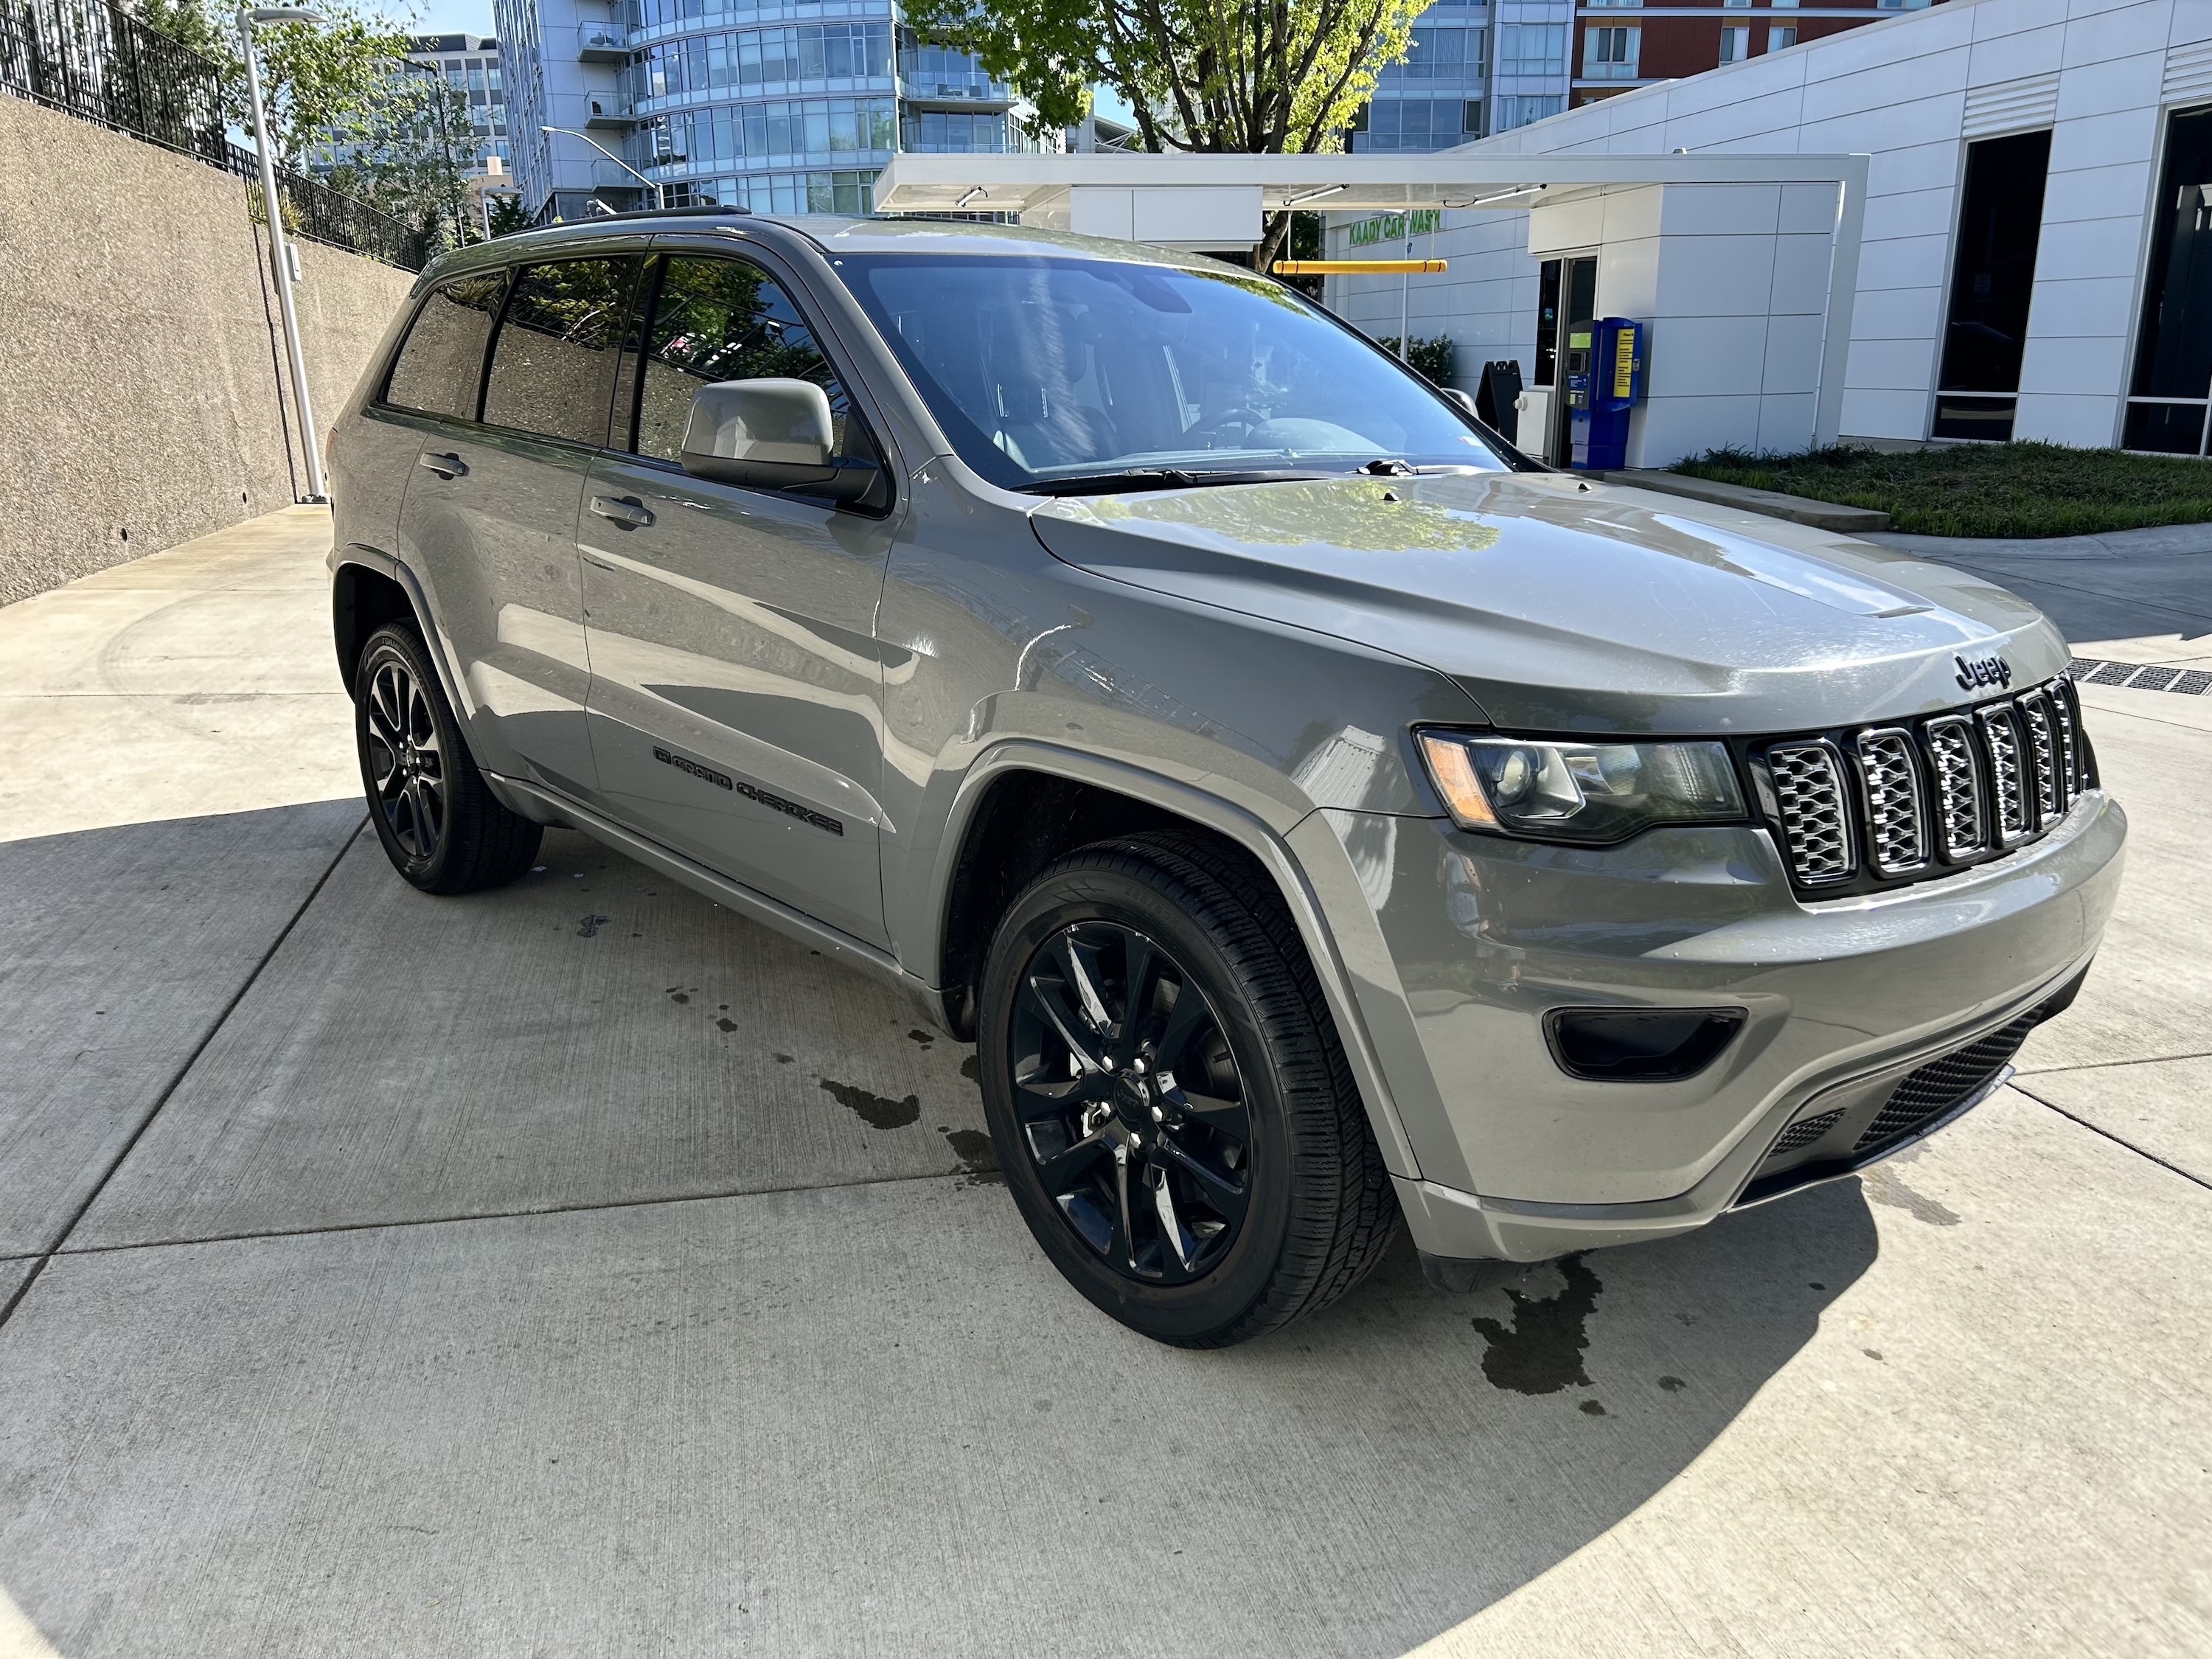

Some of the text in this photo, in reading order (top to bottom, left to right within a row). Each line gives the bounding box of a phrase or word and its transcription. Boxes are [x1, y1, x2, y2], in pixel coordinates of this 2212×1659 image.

[1349, 218, 1381, 245] KAADY
[1384, 214, 1406, 238] CAR
[381, 637, 413, 667] TORMENTA
[1955, 655, 2011, 690] Jeep
[672, 755, 844, 837] GRAND CHEROKEE
